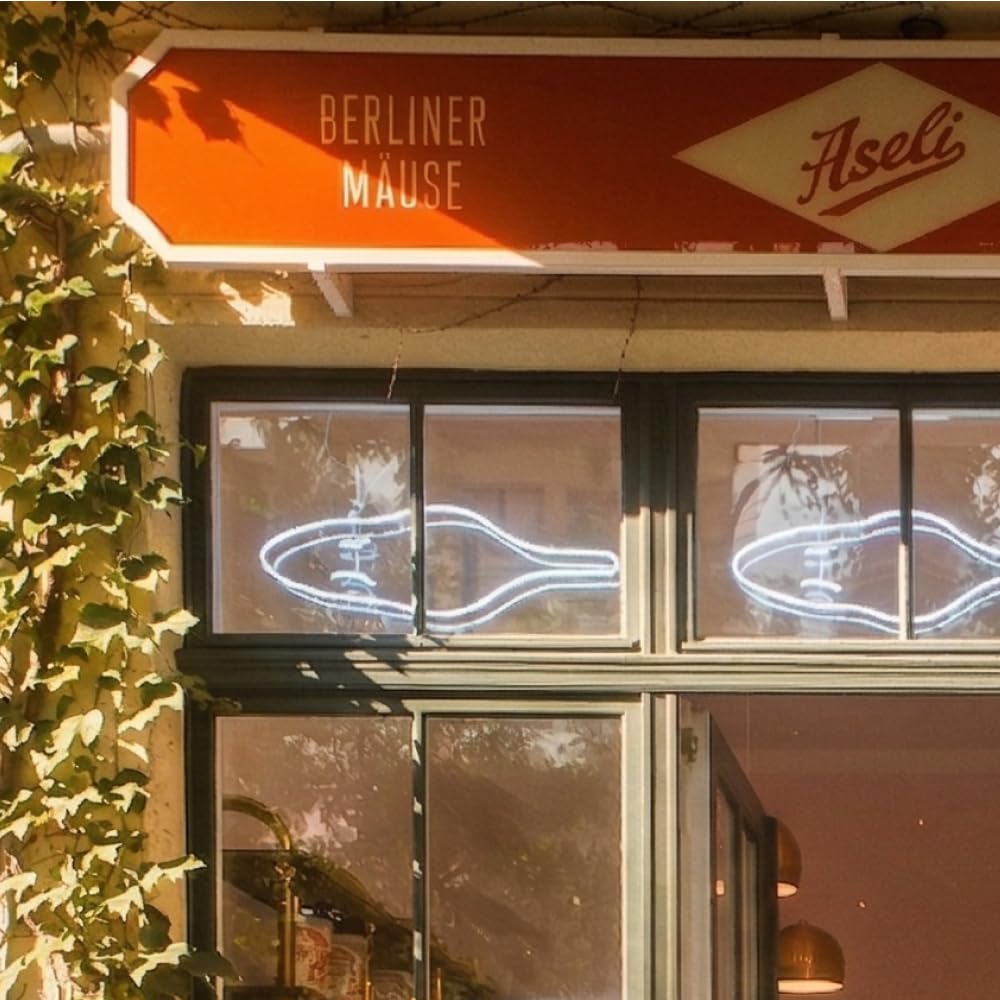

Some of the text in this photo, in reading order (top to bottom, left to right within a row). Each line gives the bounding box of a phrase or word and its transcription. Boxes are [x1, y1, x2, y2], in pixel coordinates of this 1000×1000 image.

[320, 94, 487, 146] BERLINER
[342, 152, 464, 210] MÄUSE
[797, 101, 966, 216] Aseli
